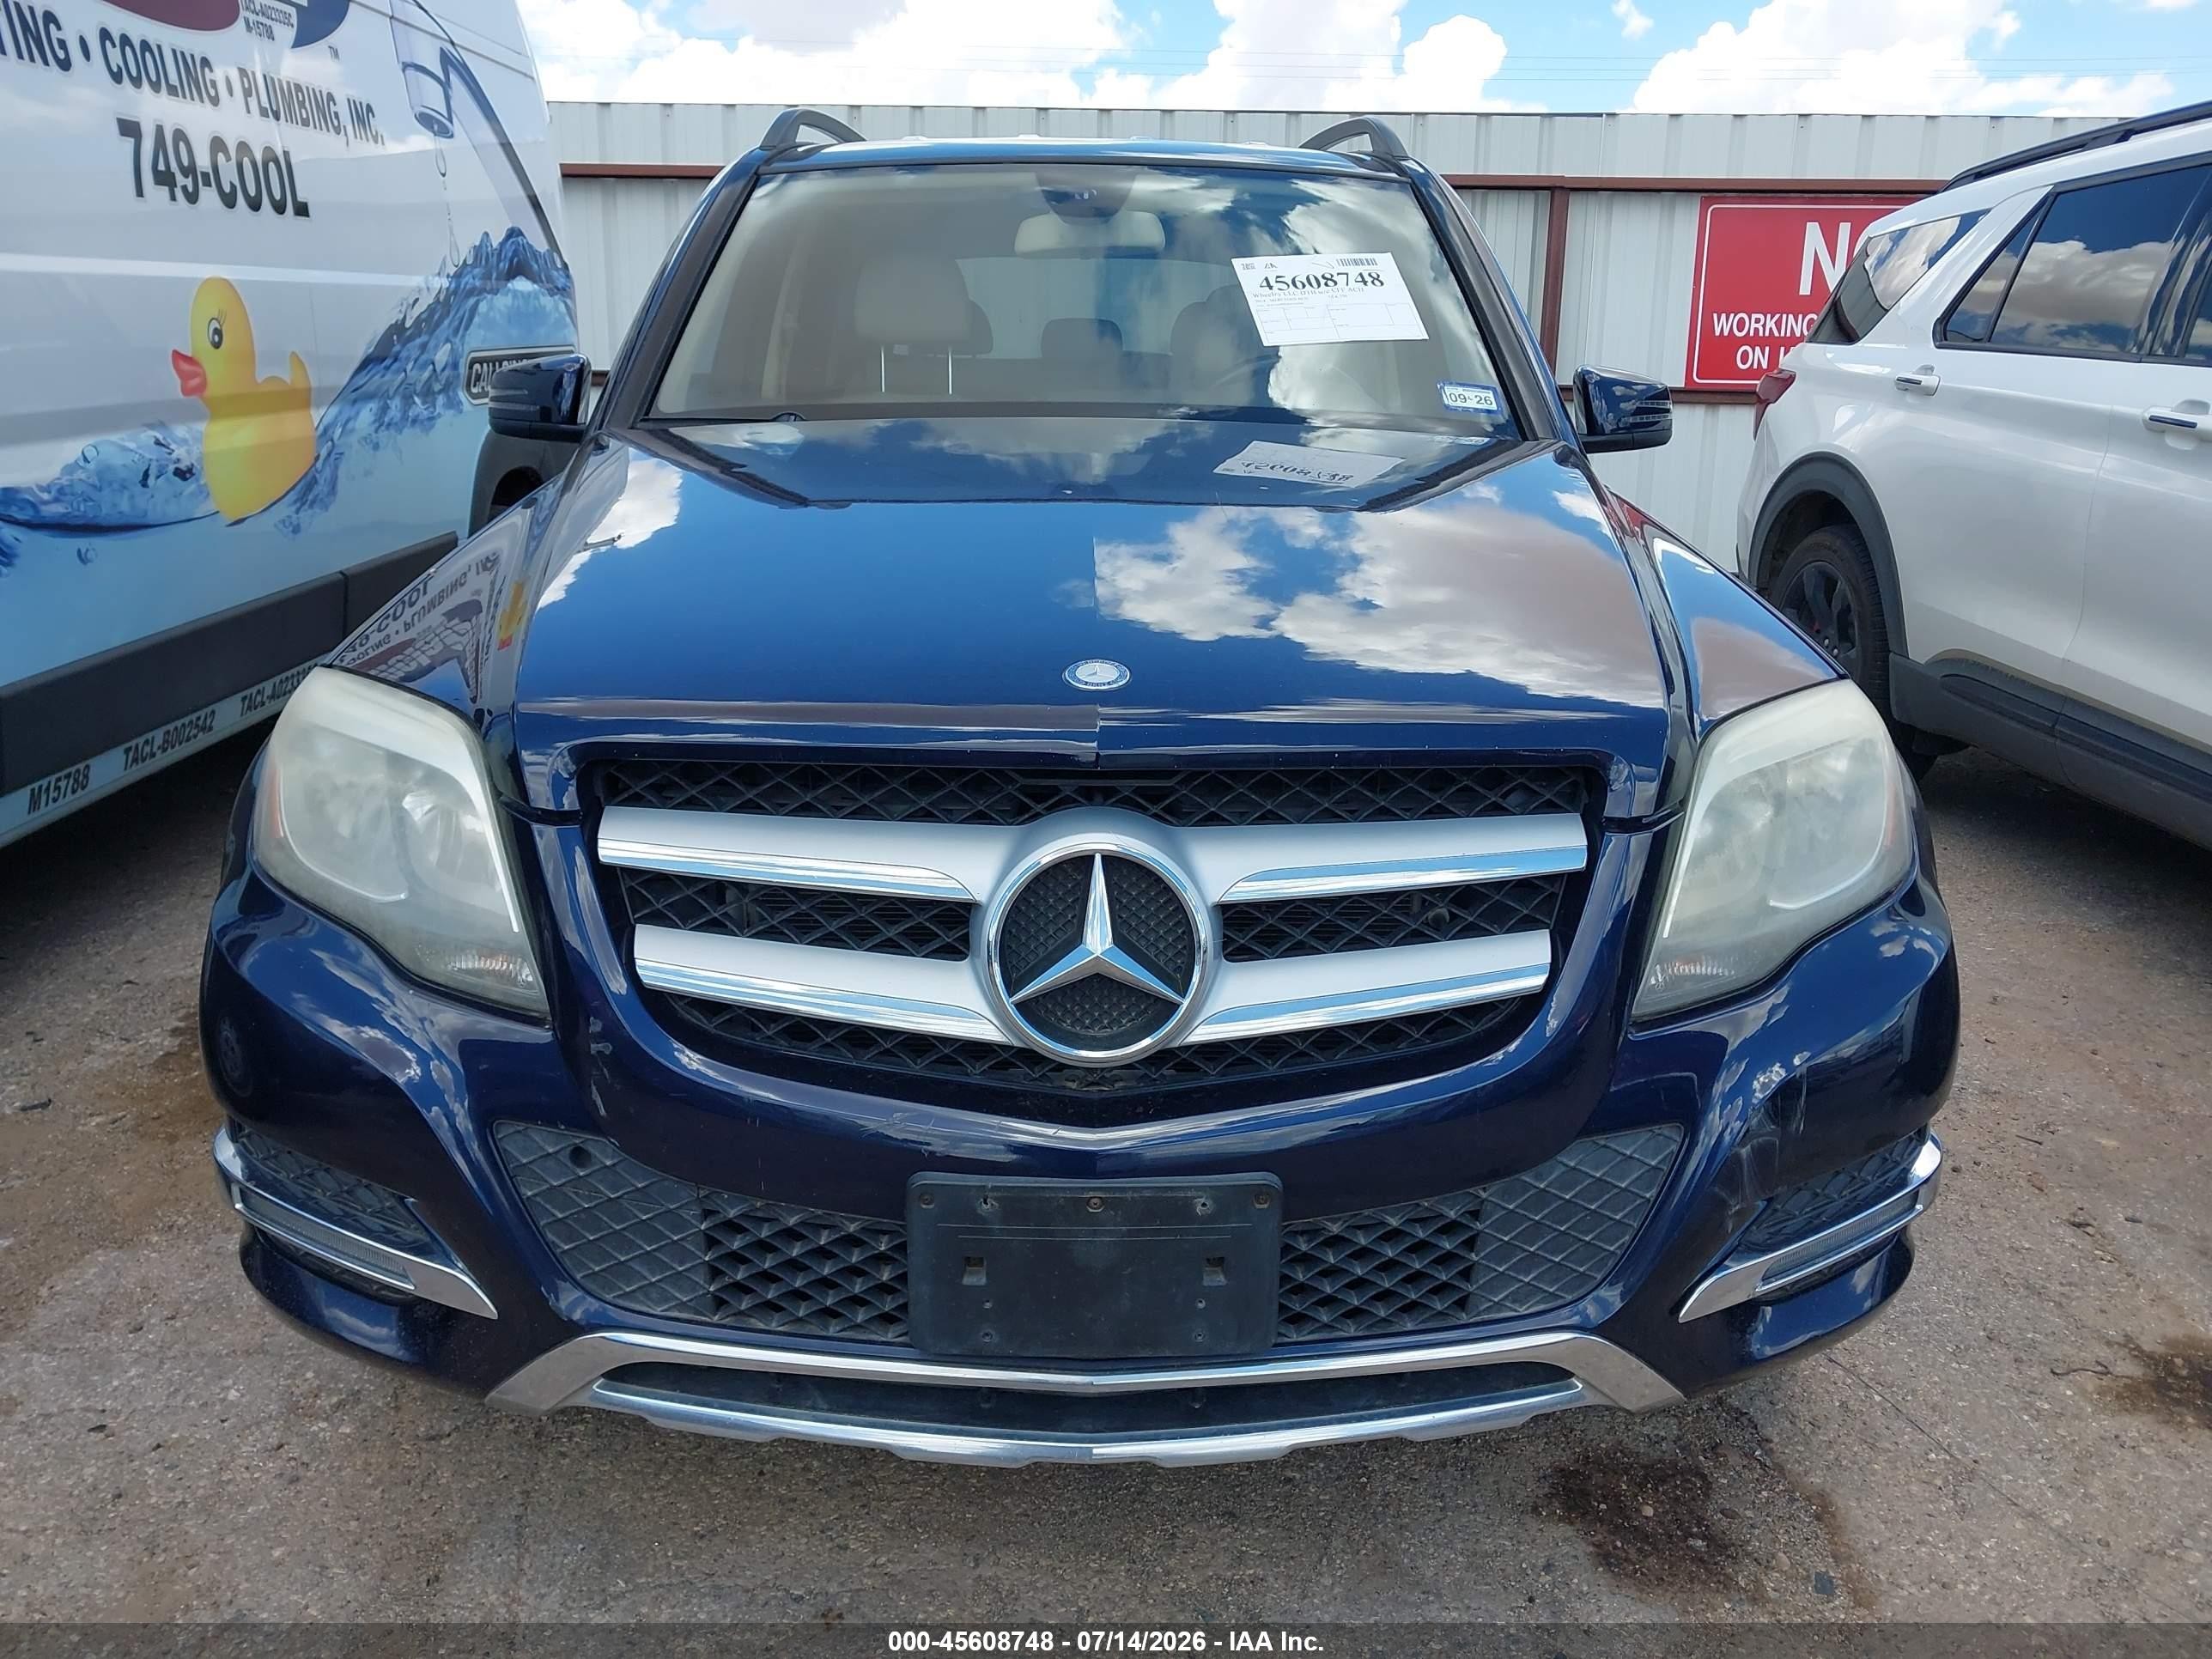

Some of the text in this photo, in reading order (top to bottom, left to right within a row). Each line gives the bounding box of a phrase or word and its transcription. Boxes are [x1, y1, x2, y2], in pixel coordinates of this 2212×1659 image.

[0, 0, 386, 147] ING COOLING PLUMBING, INC.
[116, 117, 310, 218] 749-COOL
[1259, 271, 1385, 291] 45608748
[1798, 221, 1873, 296] N
[1736, 345, 1769, 370] ON
[1449, 392, 1493, 406] 09 26
[27, 764, 91, 815] M15788
[123, 709, 217, 771] TACL-B002542
